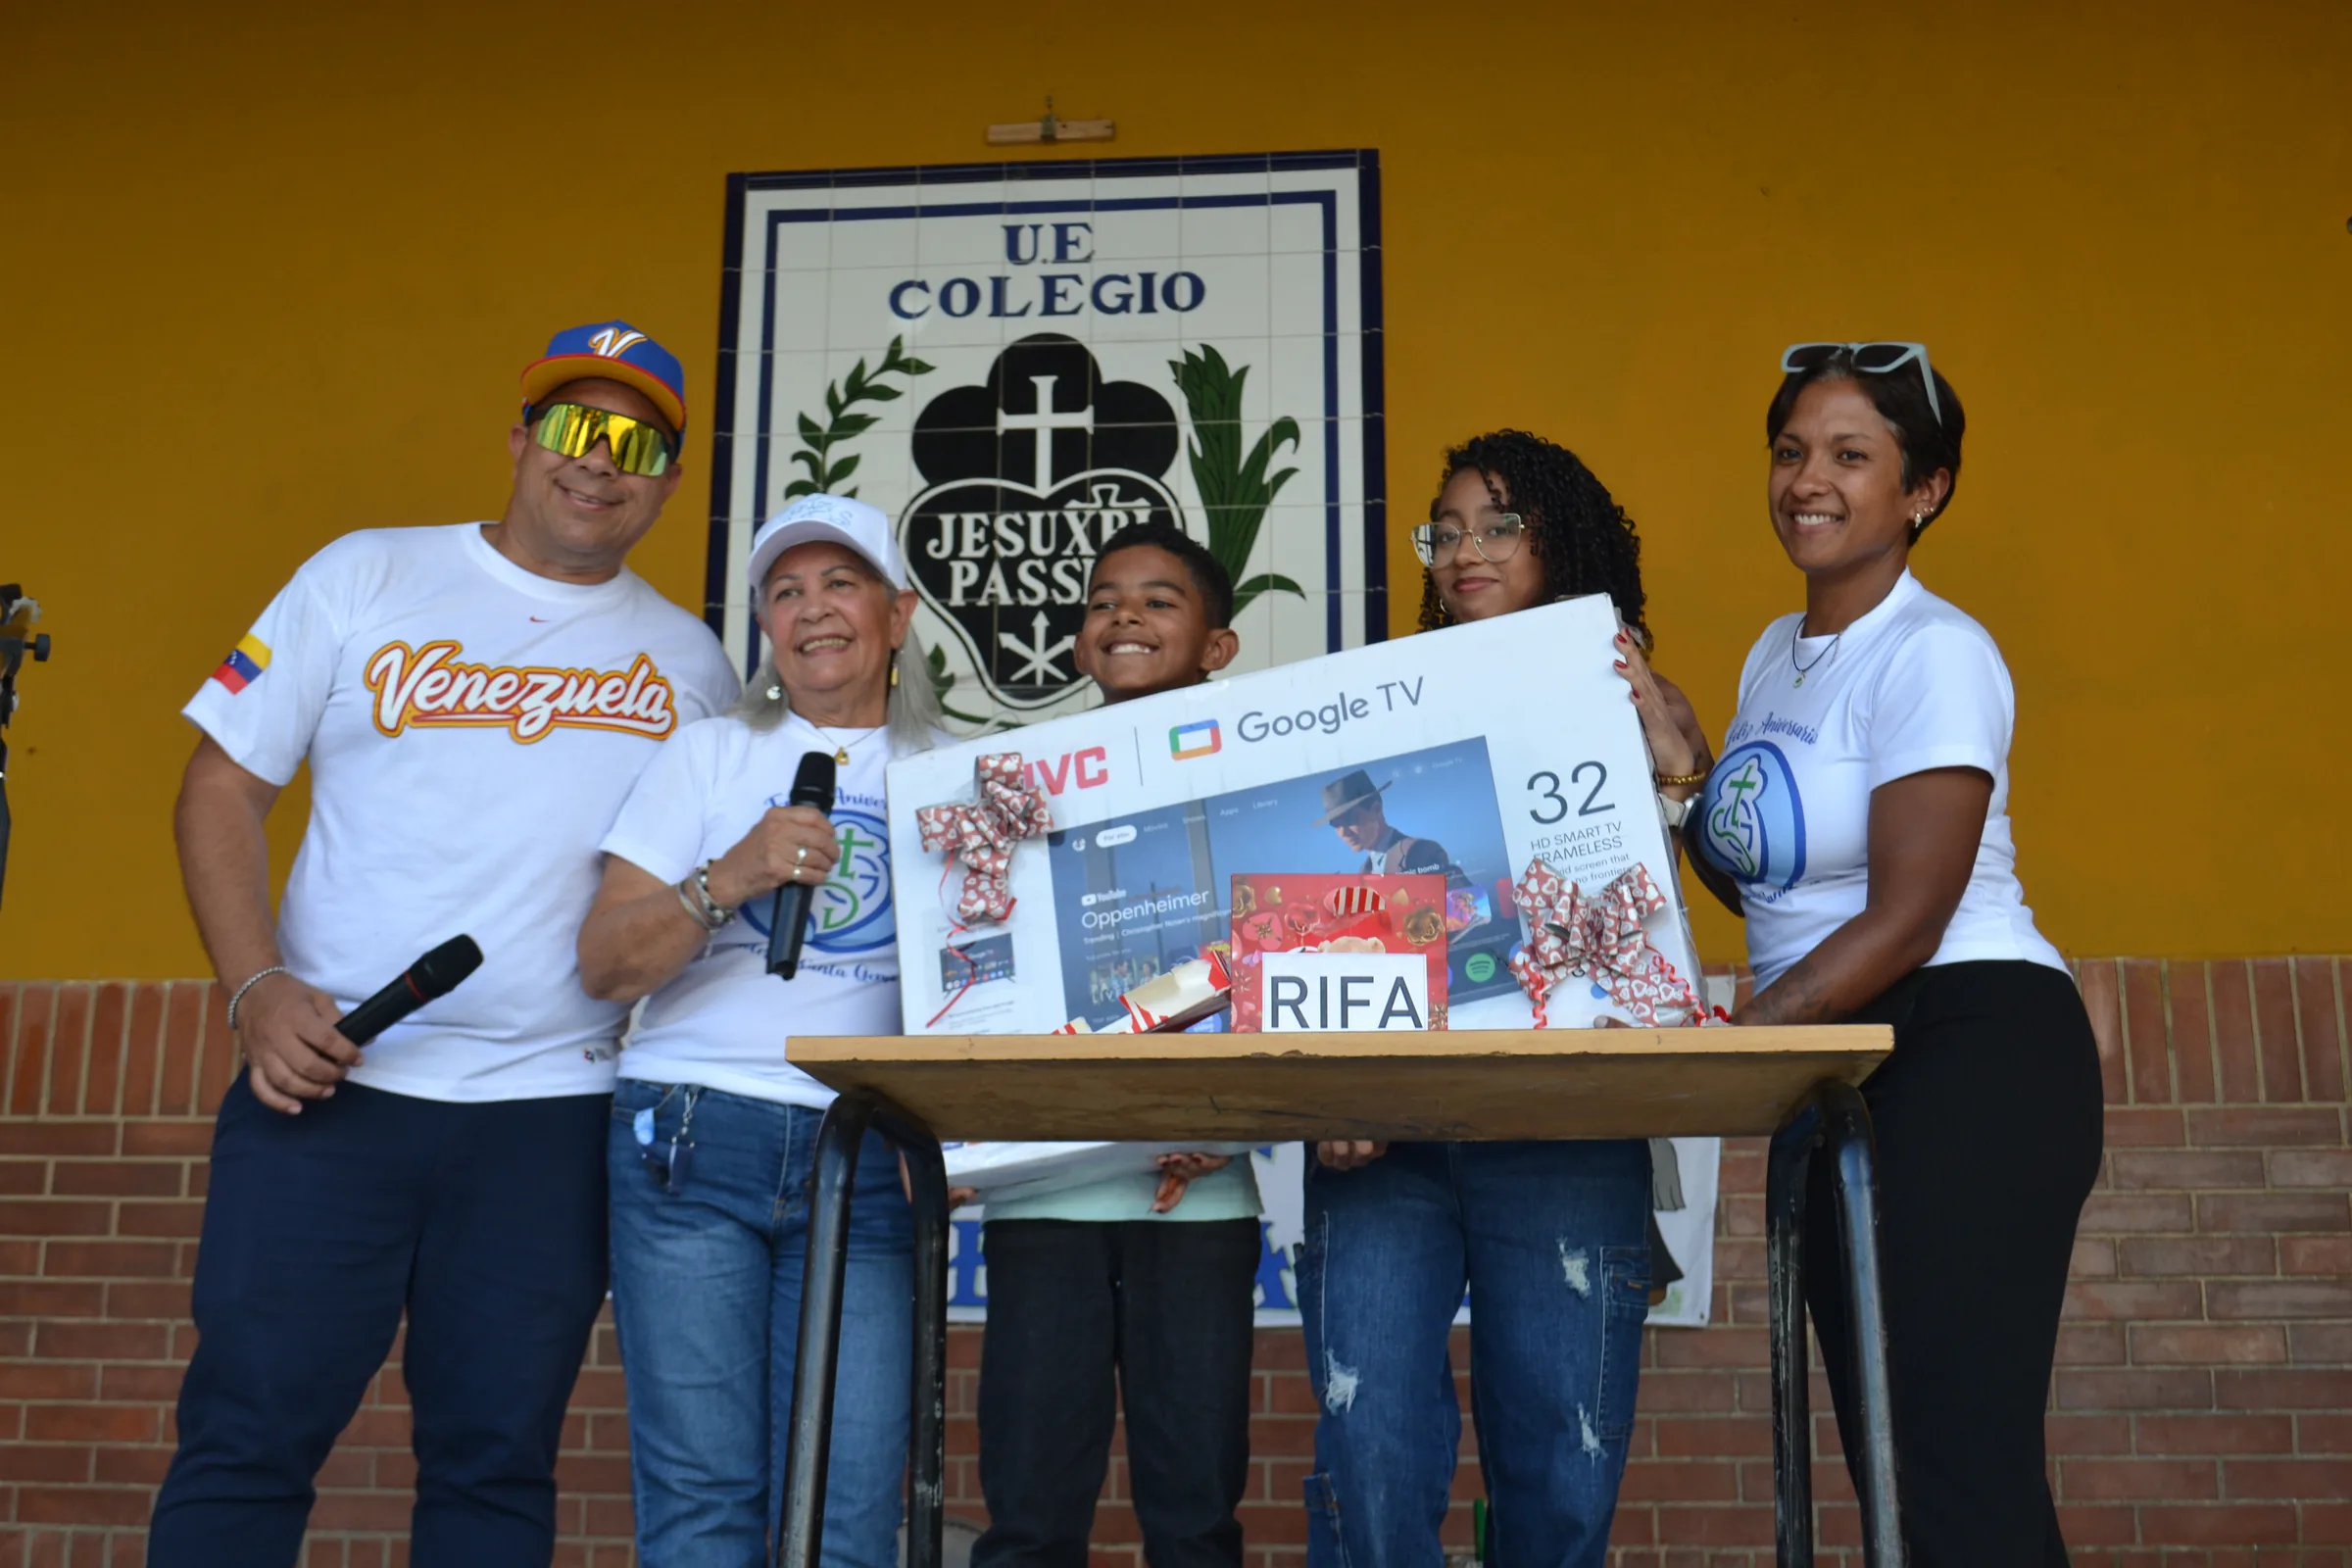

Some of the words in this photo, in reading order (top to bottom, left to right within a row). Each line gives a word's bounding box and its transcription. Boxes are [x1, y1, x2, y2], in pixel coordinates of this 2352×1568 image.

[888, 272, 1206, 320] COLEGIO
[589, 327, 648, 359] V
[926, 510, 1152, 559] JESUXP
[365, 640, 678, 745] Venezuela
[1237, 692, 1370, 743] Google
[1376, 676, 1424, 711] TV
[1761, 710, 1818, 745] Aniversario
[1527, 760, 1616, 824] 32
[1530, 836, 1551, 852] HD
[1553, 824, 1601, 846] SMART
[1604, 821, 1622, 835] TV
[1417, 862, 1440, 874] bomb
[1573, 858, 1608, 872] screen
[1610, 852, 1631, 864] that
[1591, 865, 1630, 883] frontier
[1081, 890, 1209, 930] Oppenheimer
[1097, 889, 1127, 903] YouTube
[1083, 932, 1115, 946] Trending
[1270, 975, 1423, 1030] RIFA
